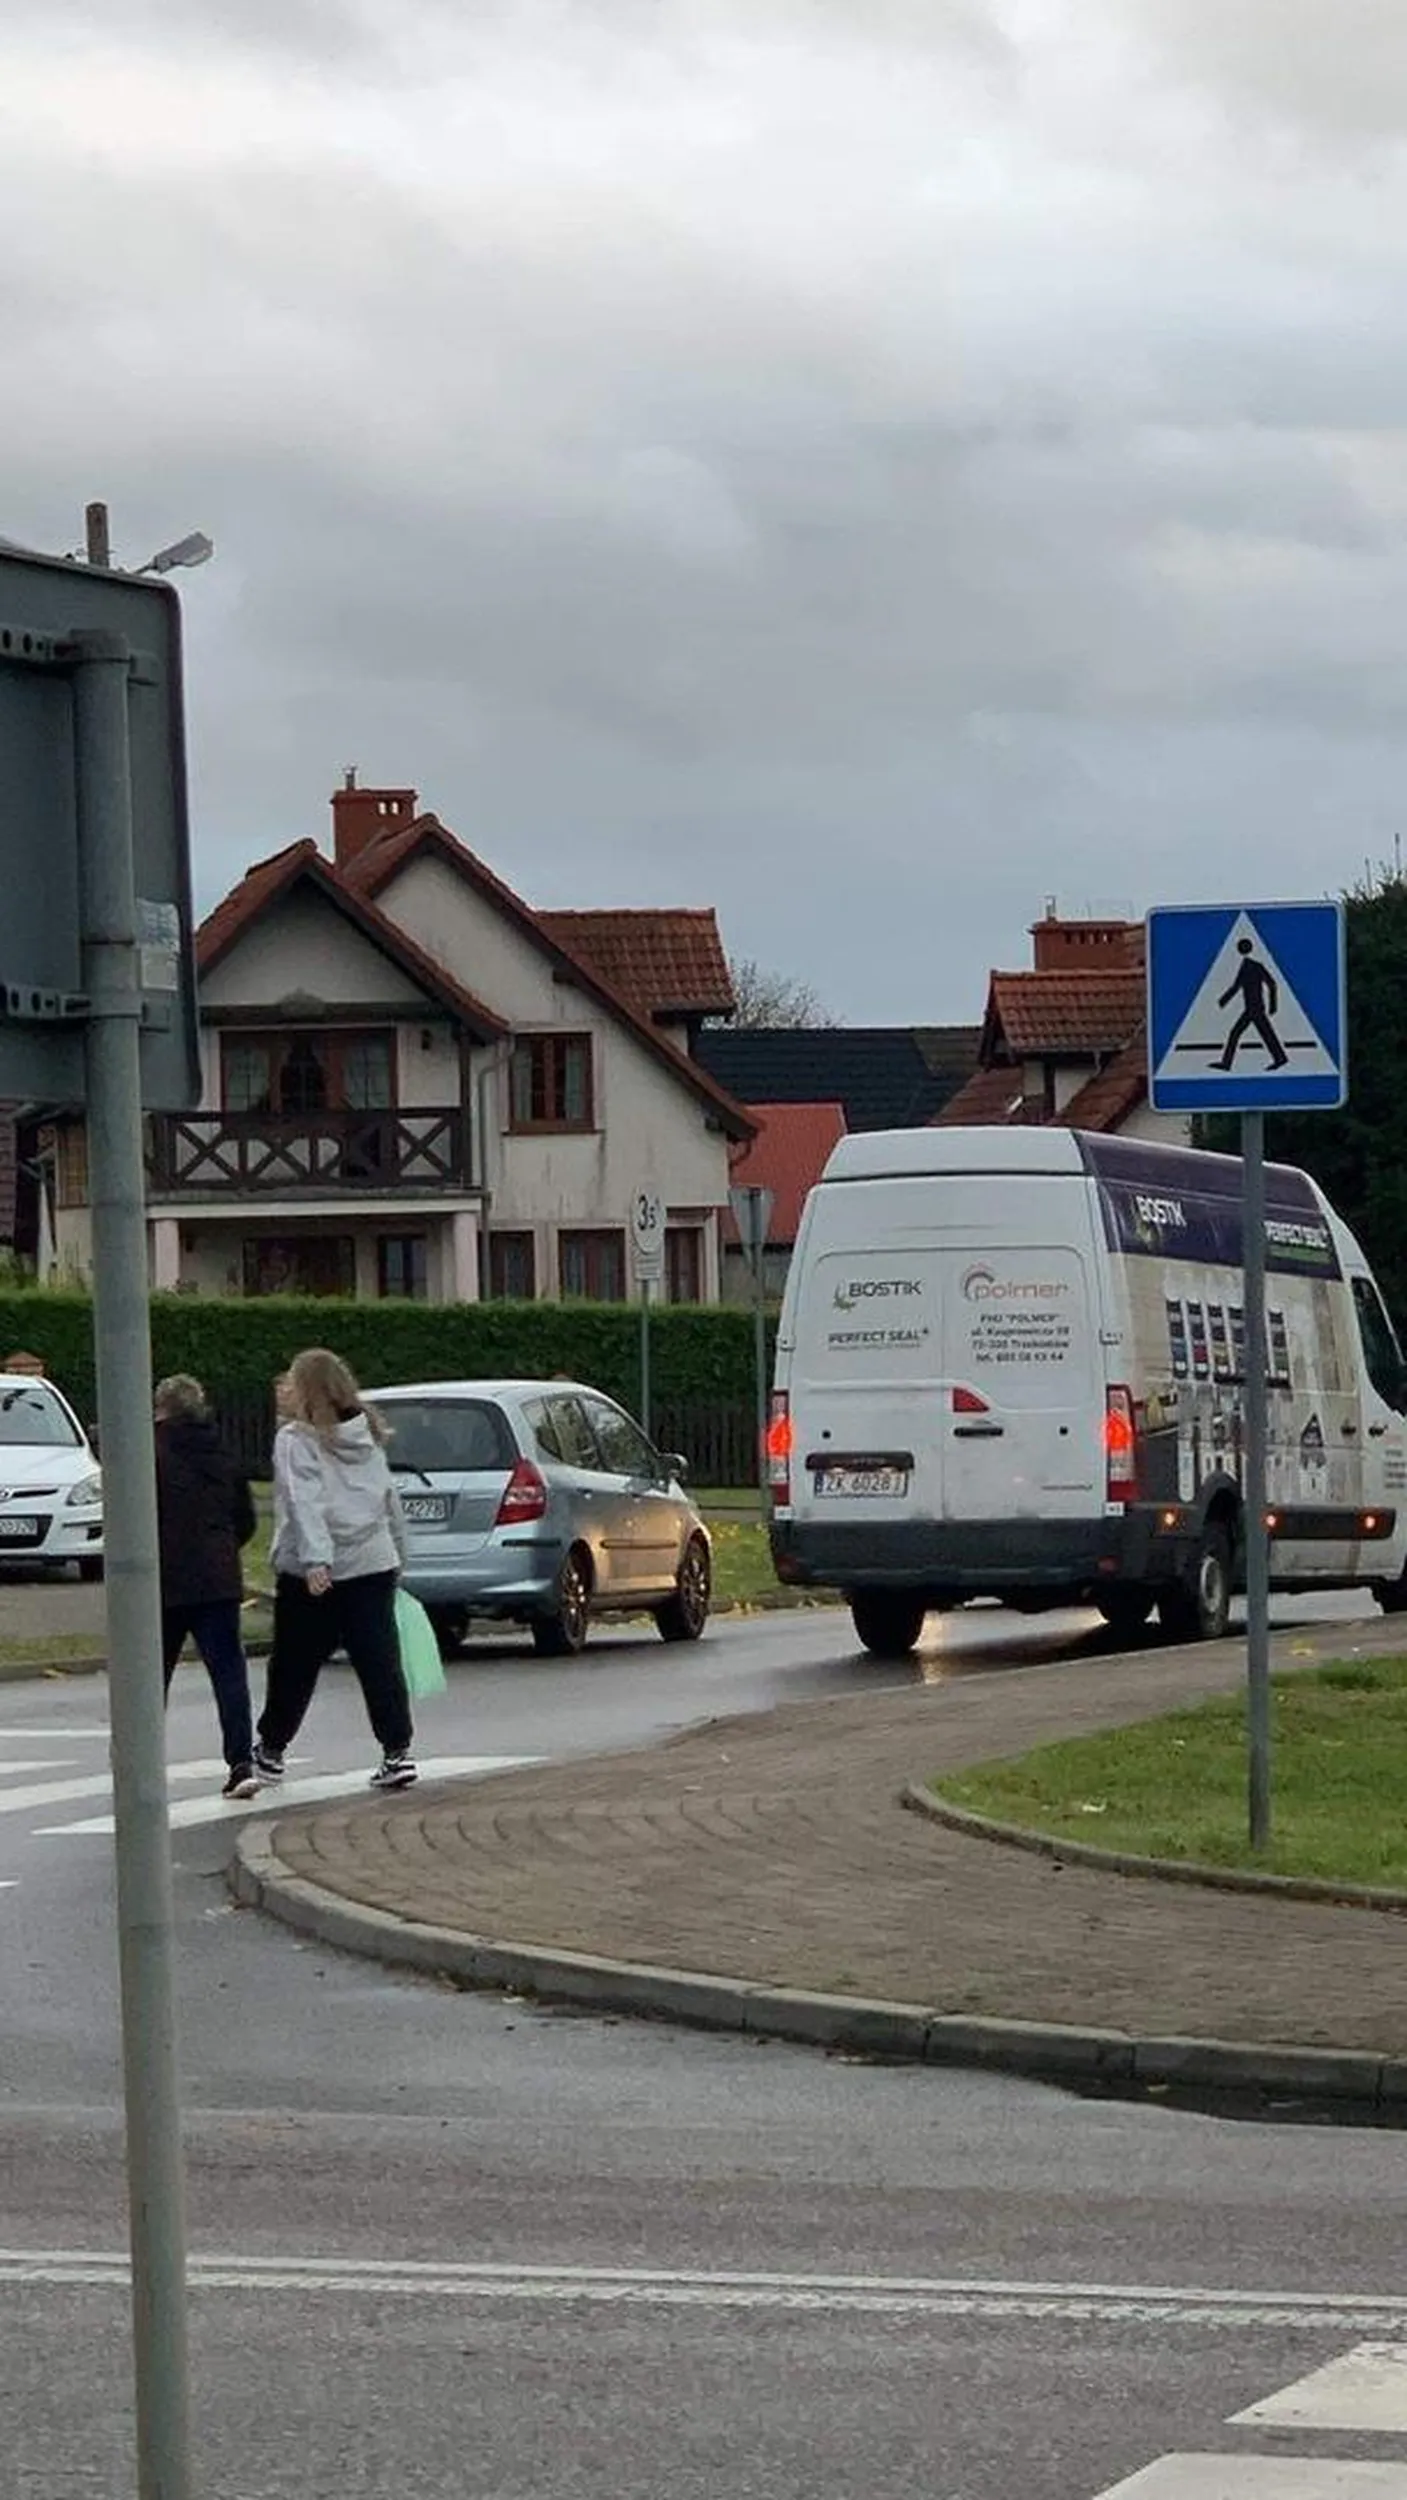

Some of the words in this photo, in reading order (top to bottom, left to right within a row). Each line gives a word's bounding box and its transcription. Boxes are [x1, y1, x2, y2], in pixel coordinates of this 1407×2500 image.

[1136, 1195, 1188, 1227] BOSTIK
[849, 1280, 922, 1297] BOSTIK
[975, 1281, 1069, 1301] polmer
[829, 1331, 885, 1343] PERFECT
[889, 1329, 919, 1341] SEAL
[827, 1472, 846, 1492] ZK
